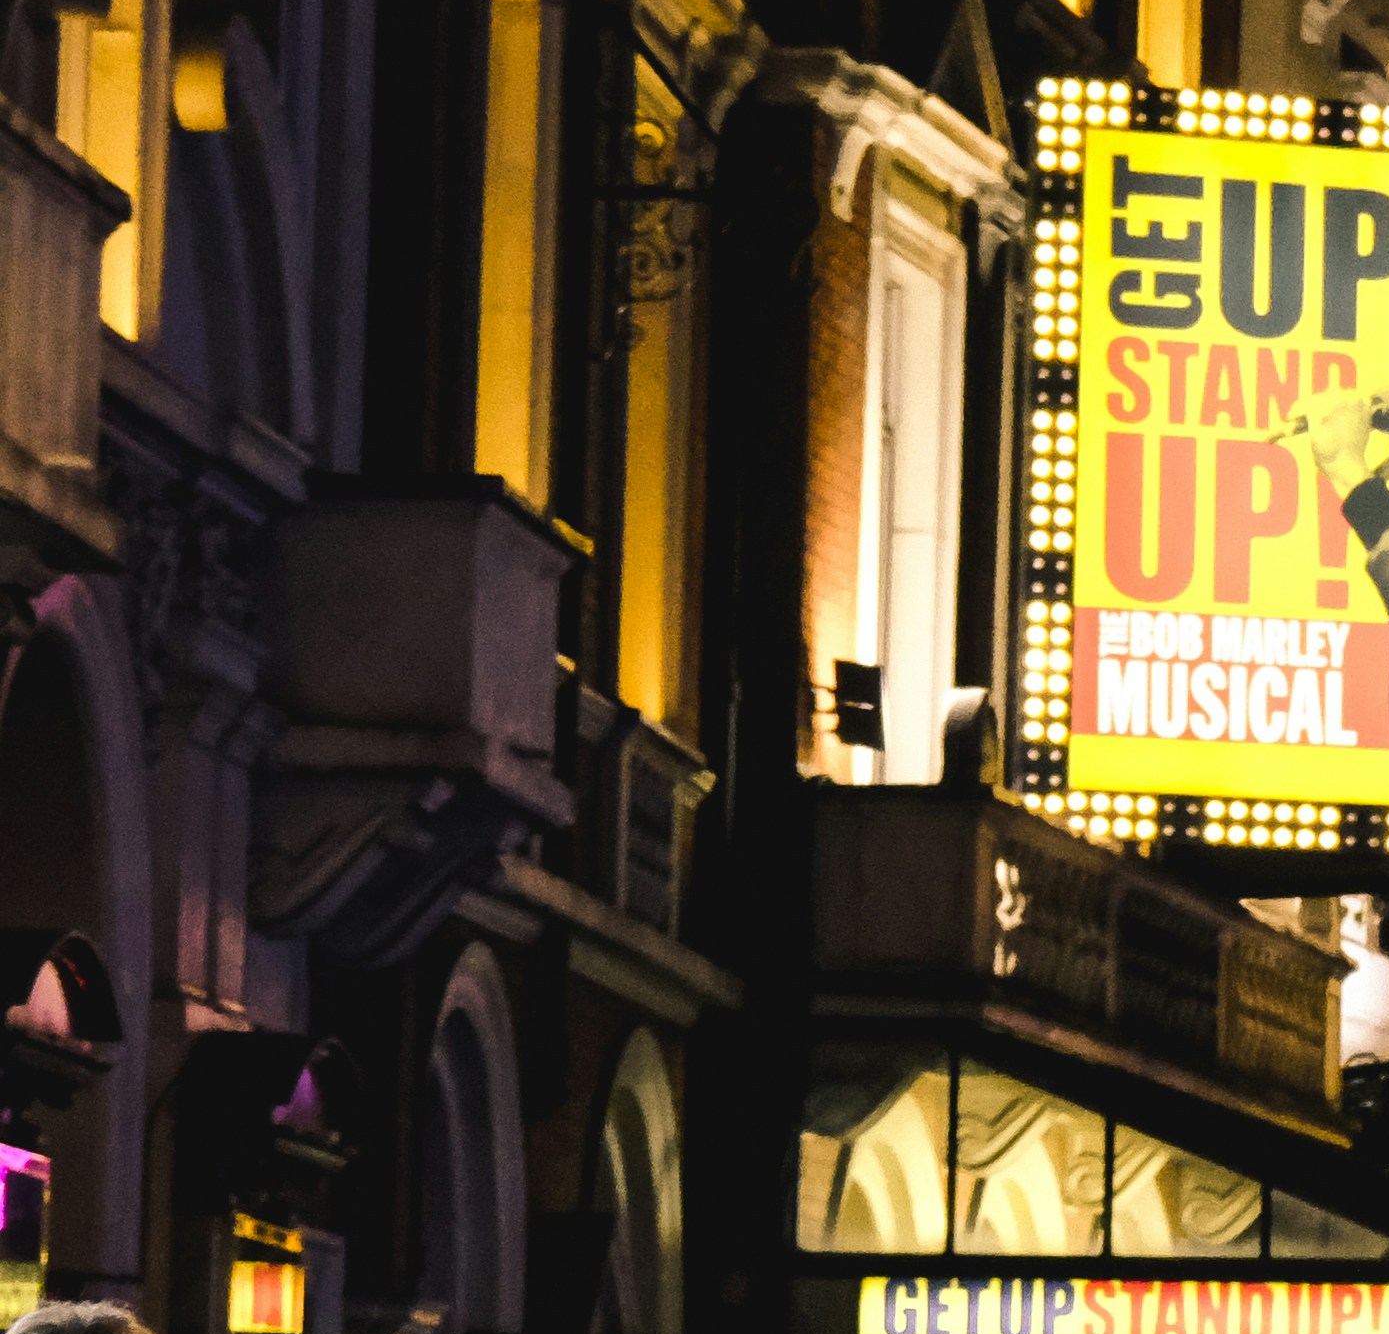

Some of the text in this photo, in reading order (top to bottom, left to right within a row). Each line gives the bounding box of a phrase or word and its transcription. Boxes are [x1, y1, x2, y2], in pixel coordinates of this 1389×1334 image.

[1109, 155, 1205, 330] GET
[1103, 431, 1350, 610] UP!
[1097, 610, 1350, 668] THE BOB MARLEY
[1097, 658, 1358, 747] MUSICAL
